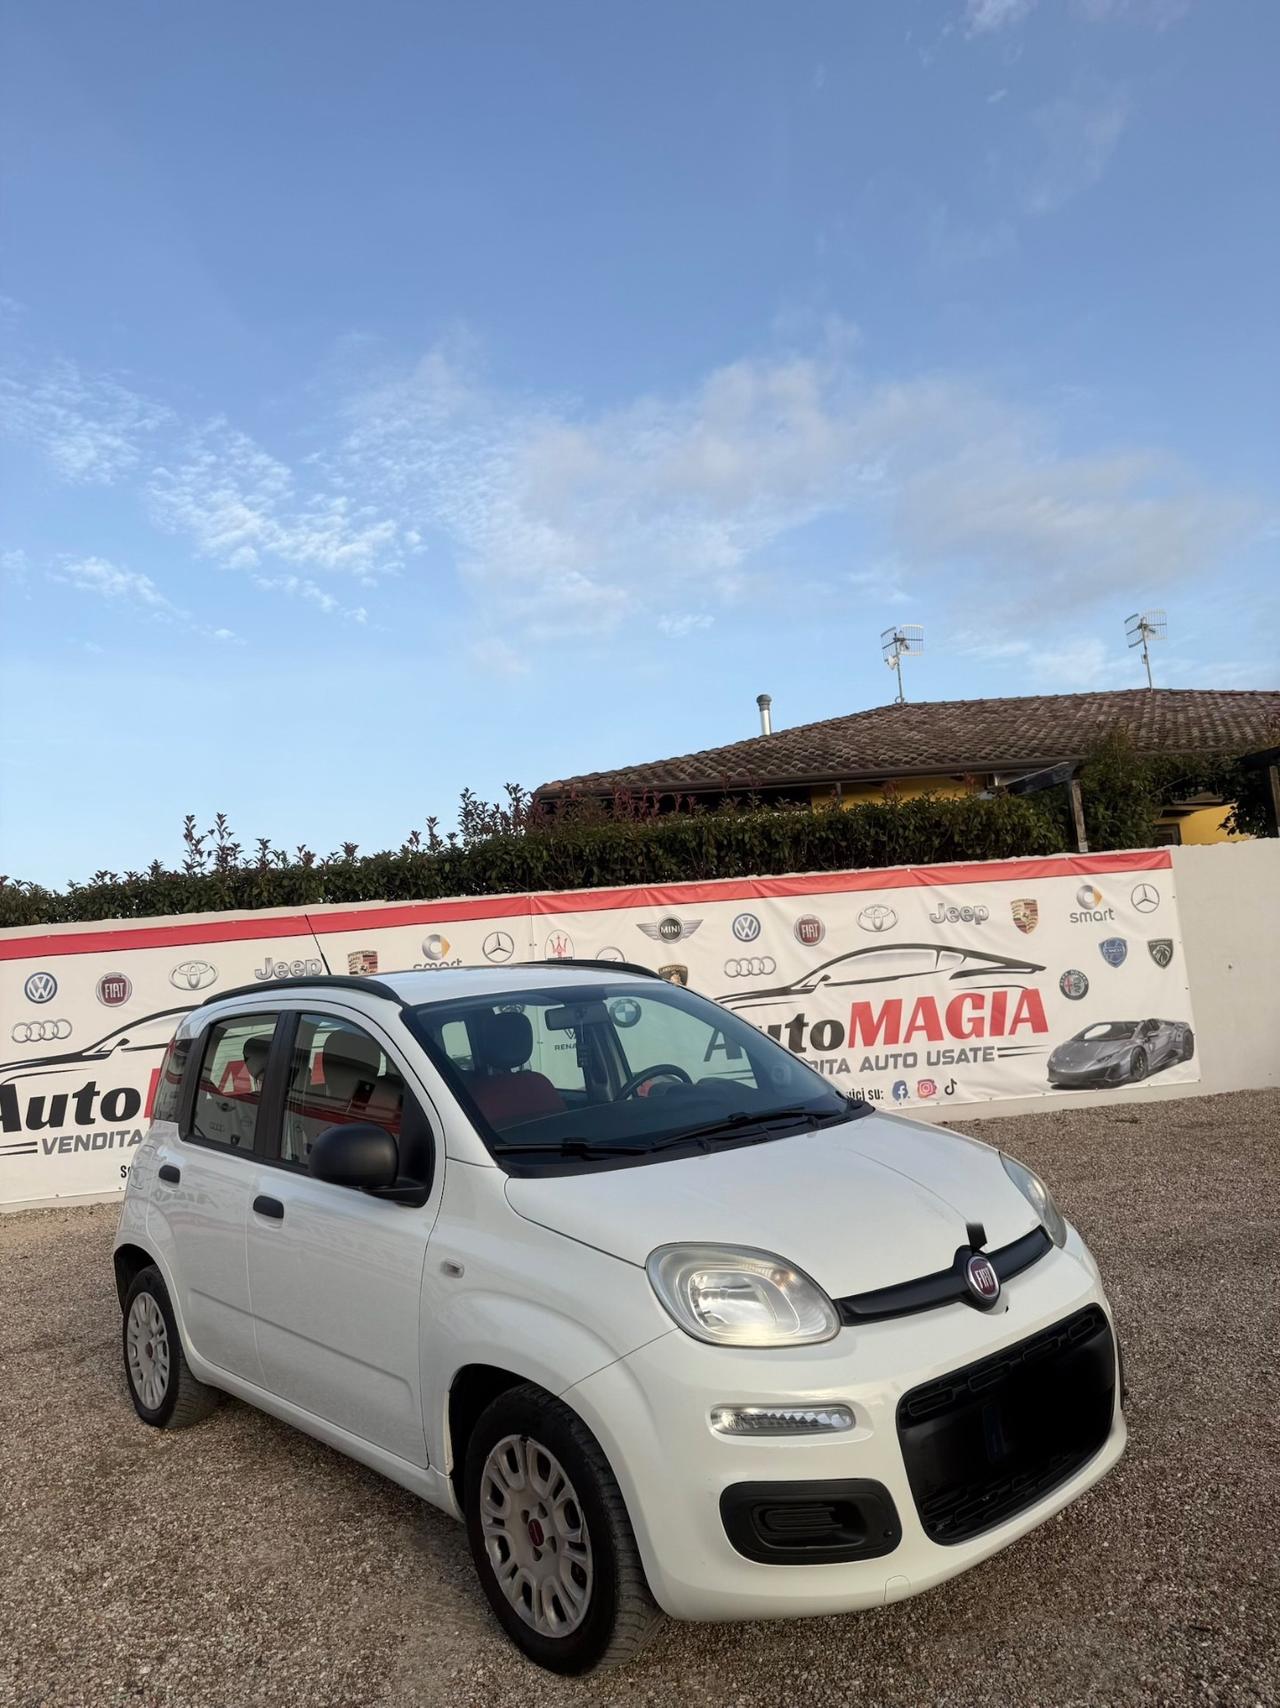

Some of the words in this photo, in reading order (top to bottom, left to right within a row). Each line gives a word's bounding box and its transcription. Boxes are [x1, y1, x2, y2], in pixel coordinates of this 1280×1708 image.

[929, 902, 989, 925] Jeep
[1070, 908, 1115, 923] smart
[660, 926, 681, 934] MINI
[801, 923, 819, 939] FIAT
[254, 957, 322, 980] Jeep
[104, 982, 125, 999] FIAT
[859, 1052, 918, 1073] AUTO
[926, 1046, 995, 1067] USATE
[868, 1089, 884, 1100] su:
[42, 1129, 144, 1155] VENDITA
